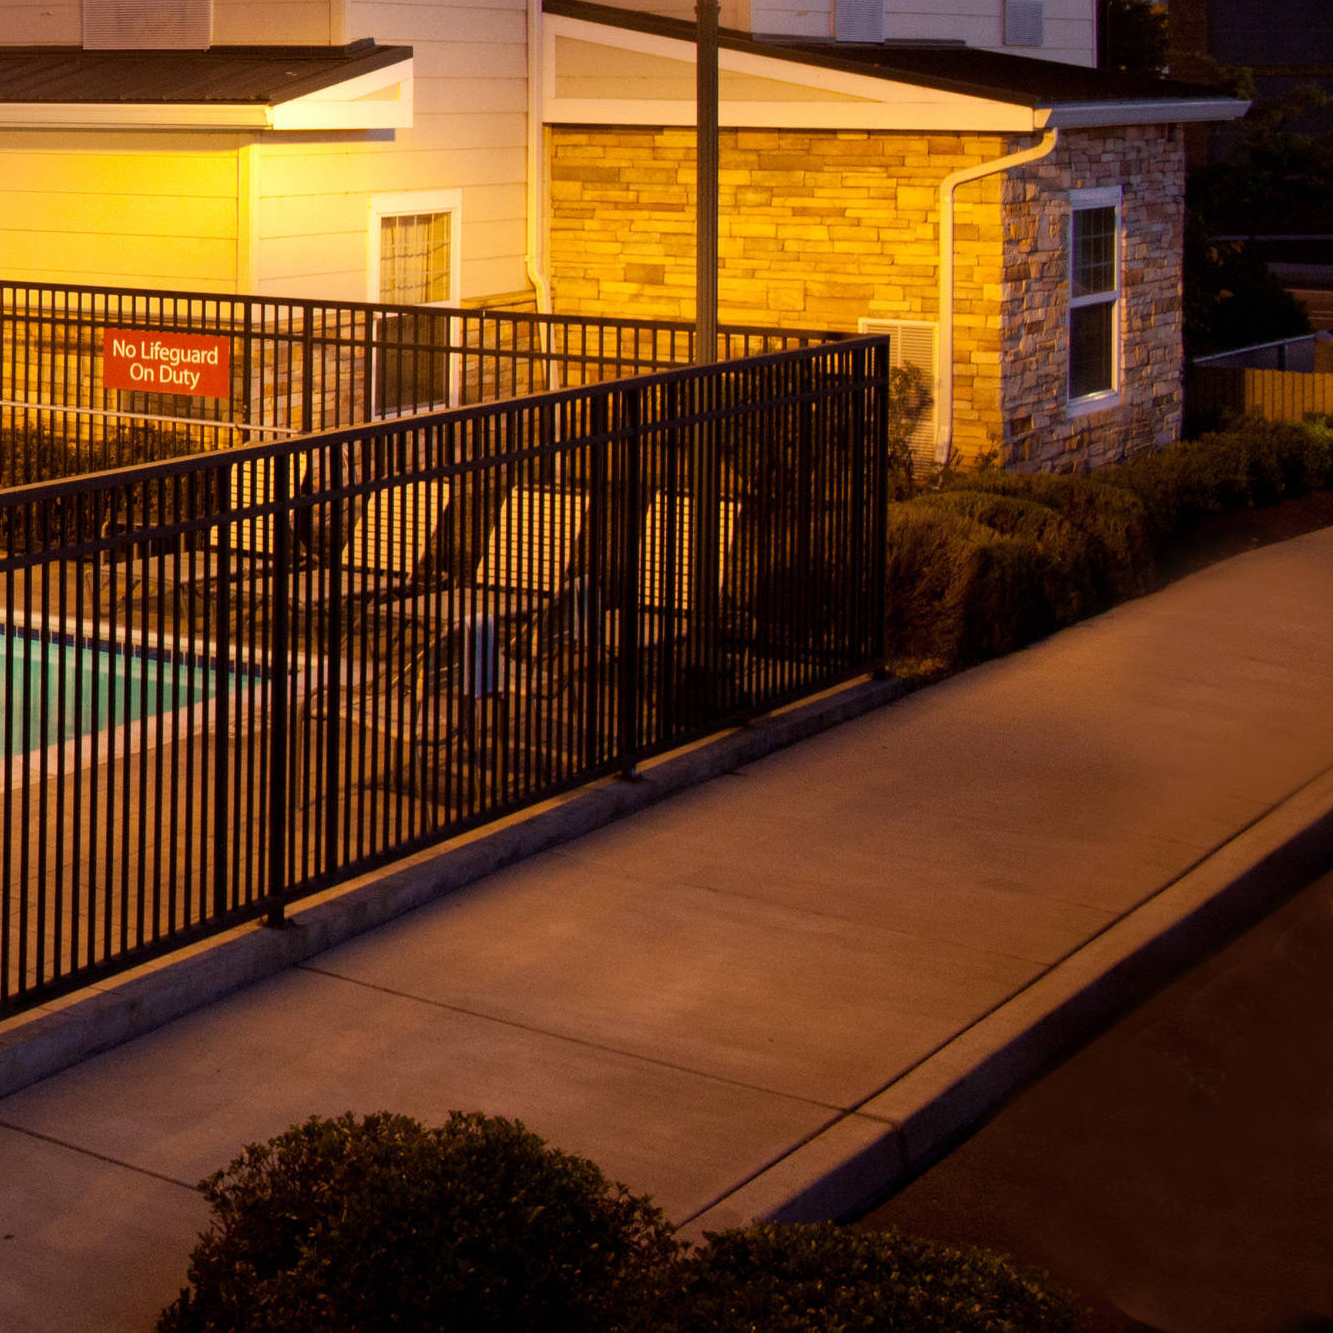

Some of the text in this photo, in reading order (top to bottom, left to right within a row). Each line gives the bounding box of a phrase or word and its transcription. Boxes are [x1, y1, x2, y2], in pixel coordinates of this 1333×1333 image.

[112, 338, 219, 366] No Lifeguard
[129, 362, 200, 390] On Duty
